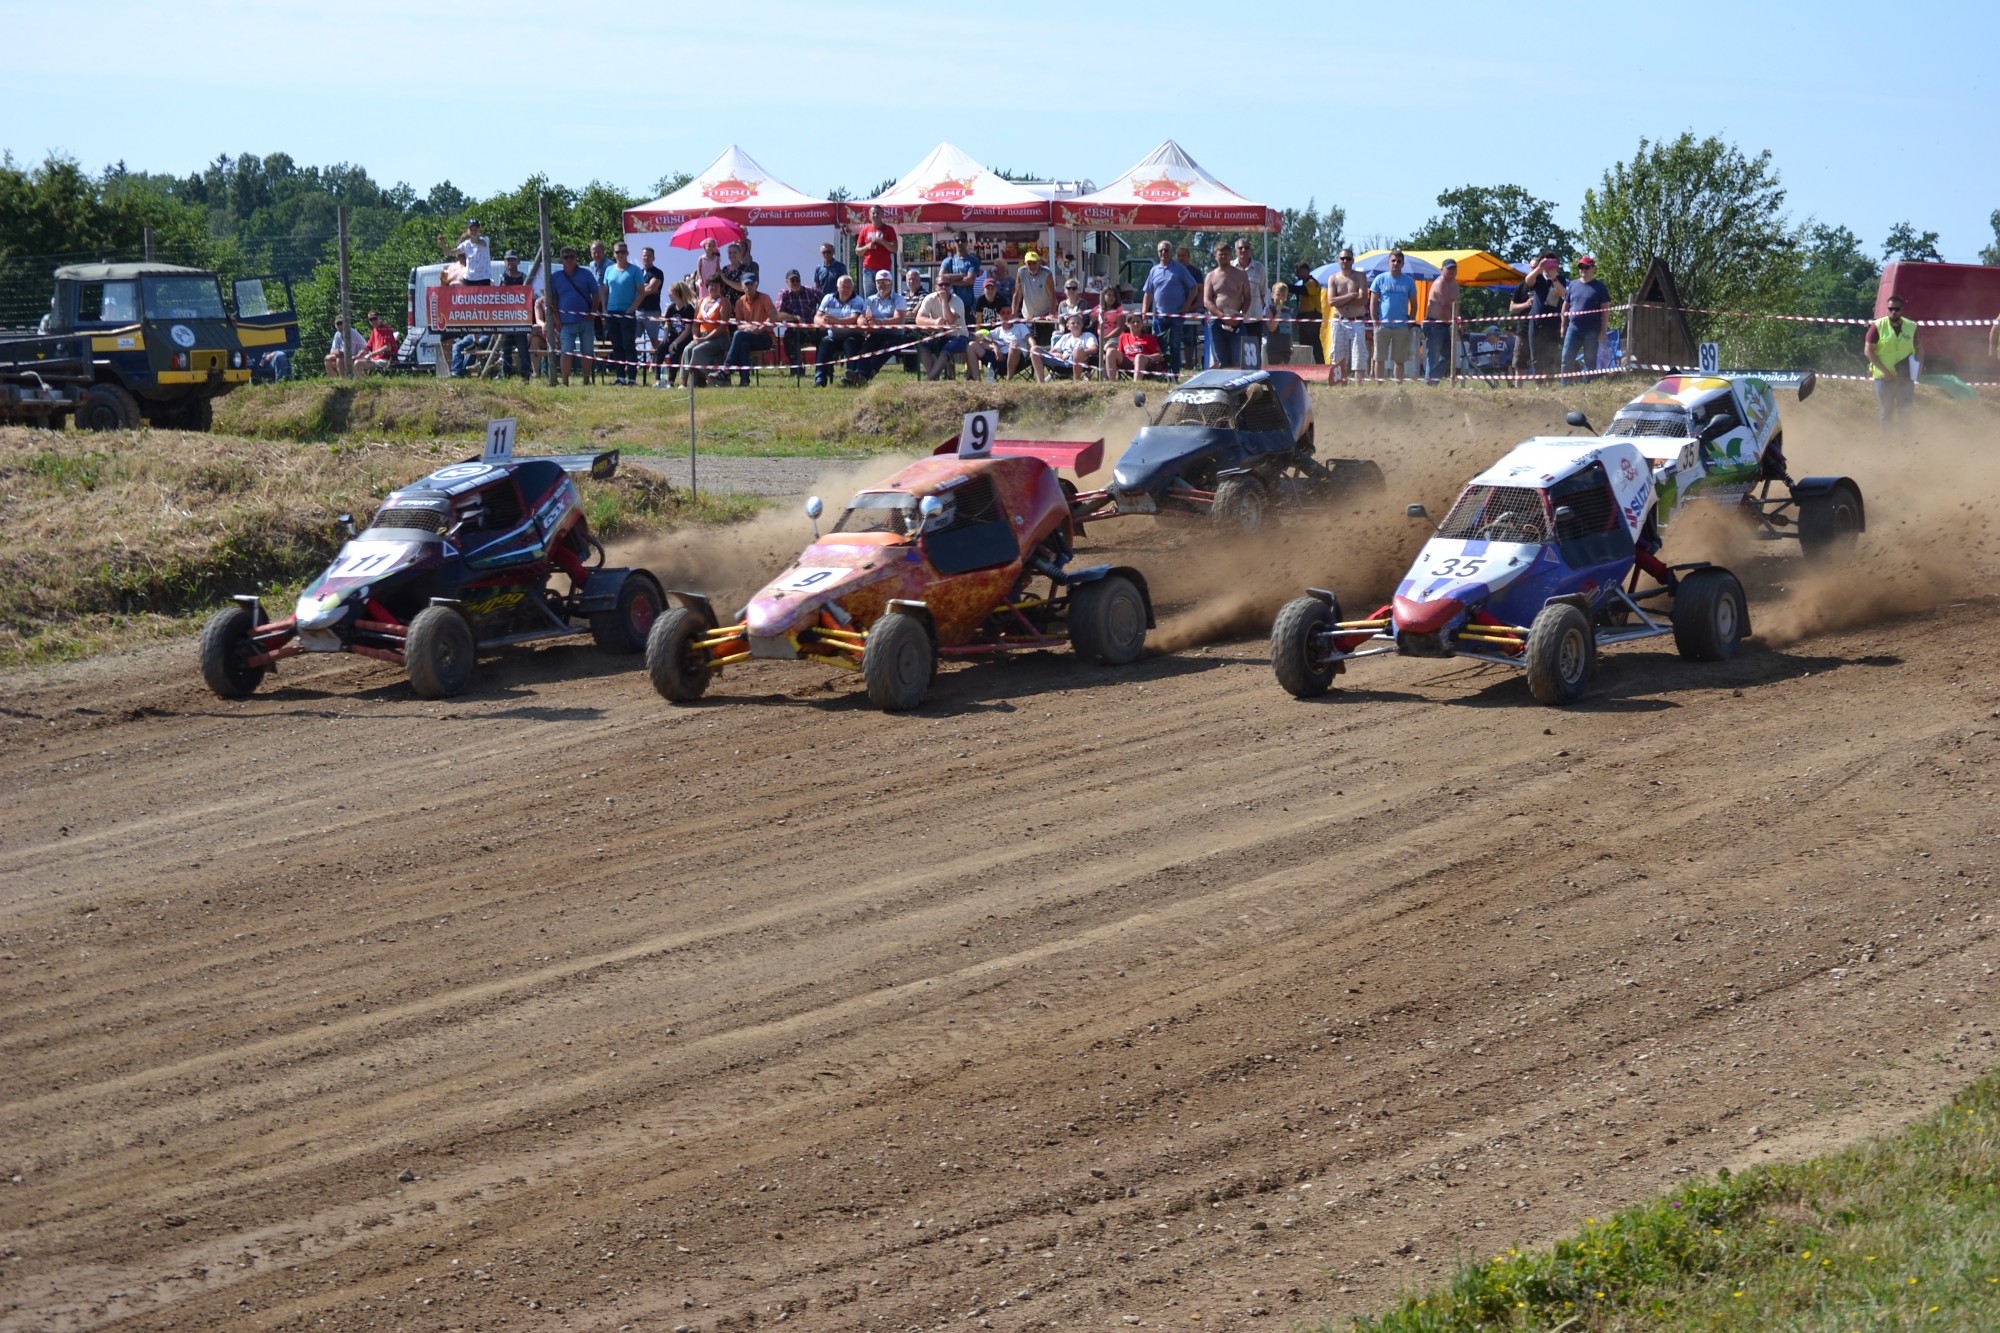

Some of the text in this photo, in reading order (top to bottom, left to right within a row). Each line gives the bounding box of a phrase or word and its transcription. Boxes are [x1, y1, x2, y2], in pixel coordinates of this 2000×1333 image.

[748, 207, 782, 224] Garšai
[784, 210, 792, 218] ir
[961, 205, 995, 220] Garšai
[997, 206, 1005, 215] ir
[1177, 205, 1212, 223] Garšai
[1214, 210, 1223, 219] ir
[451, 291, 526, 305] UGUNSDZĒSĪBAS
[448, 307, 490, 321] APARĀTU
[492, 309, 529, 321] SERVISS
[1243, 342, 1258, 366] 33
[1700, 343, 1716, 372] 89
[494, 425, 507, 455] 11
[971, 414, 990, 451] 9
[1682, 442, 1695, 470] 35
[347, 553, 392, 572] 11
[1431, 557, 1488, 578] 35
[792, 571, 833, 588] 9
